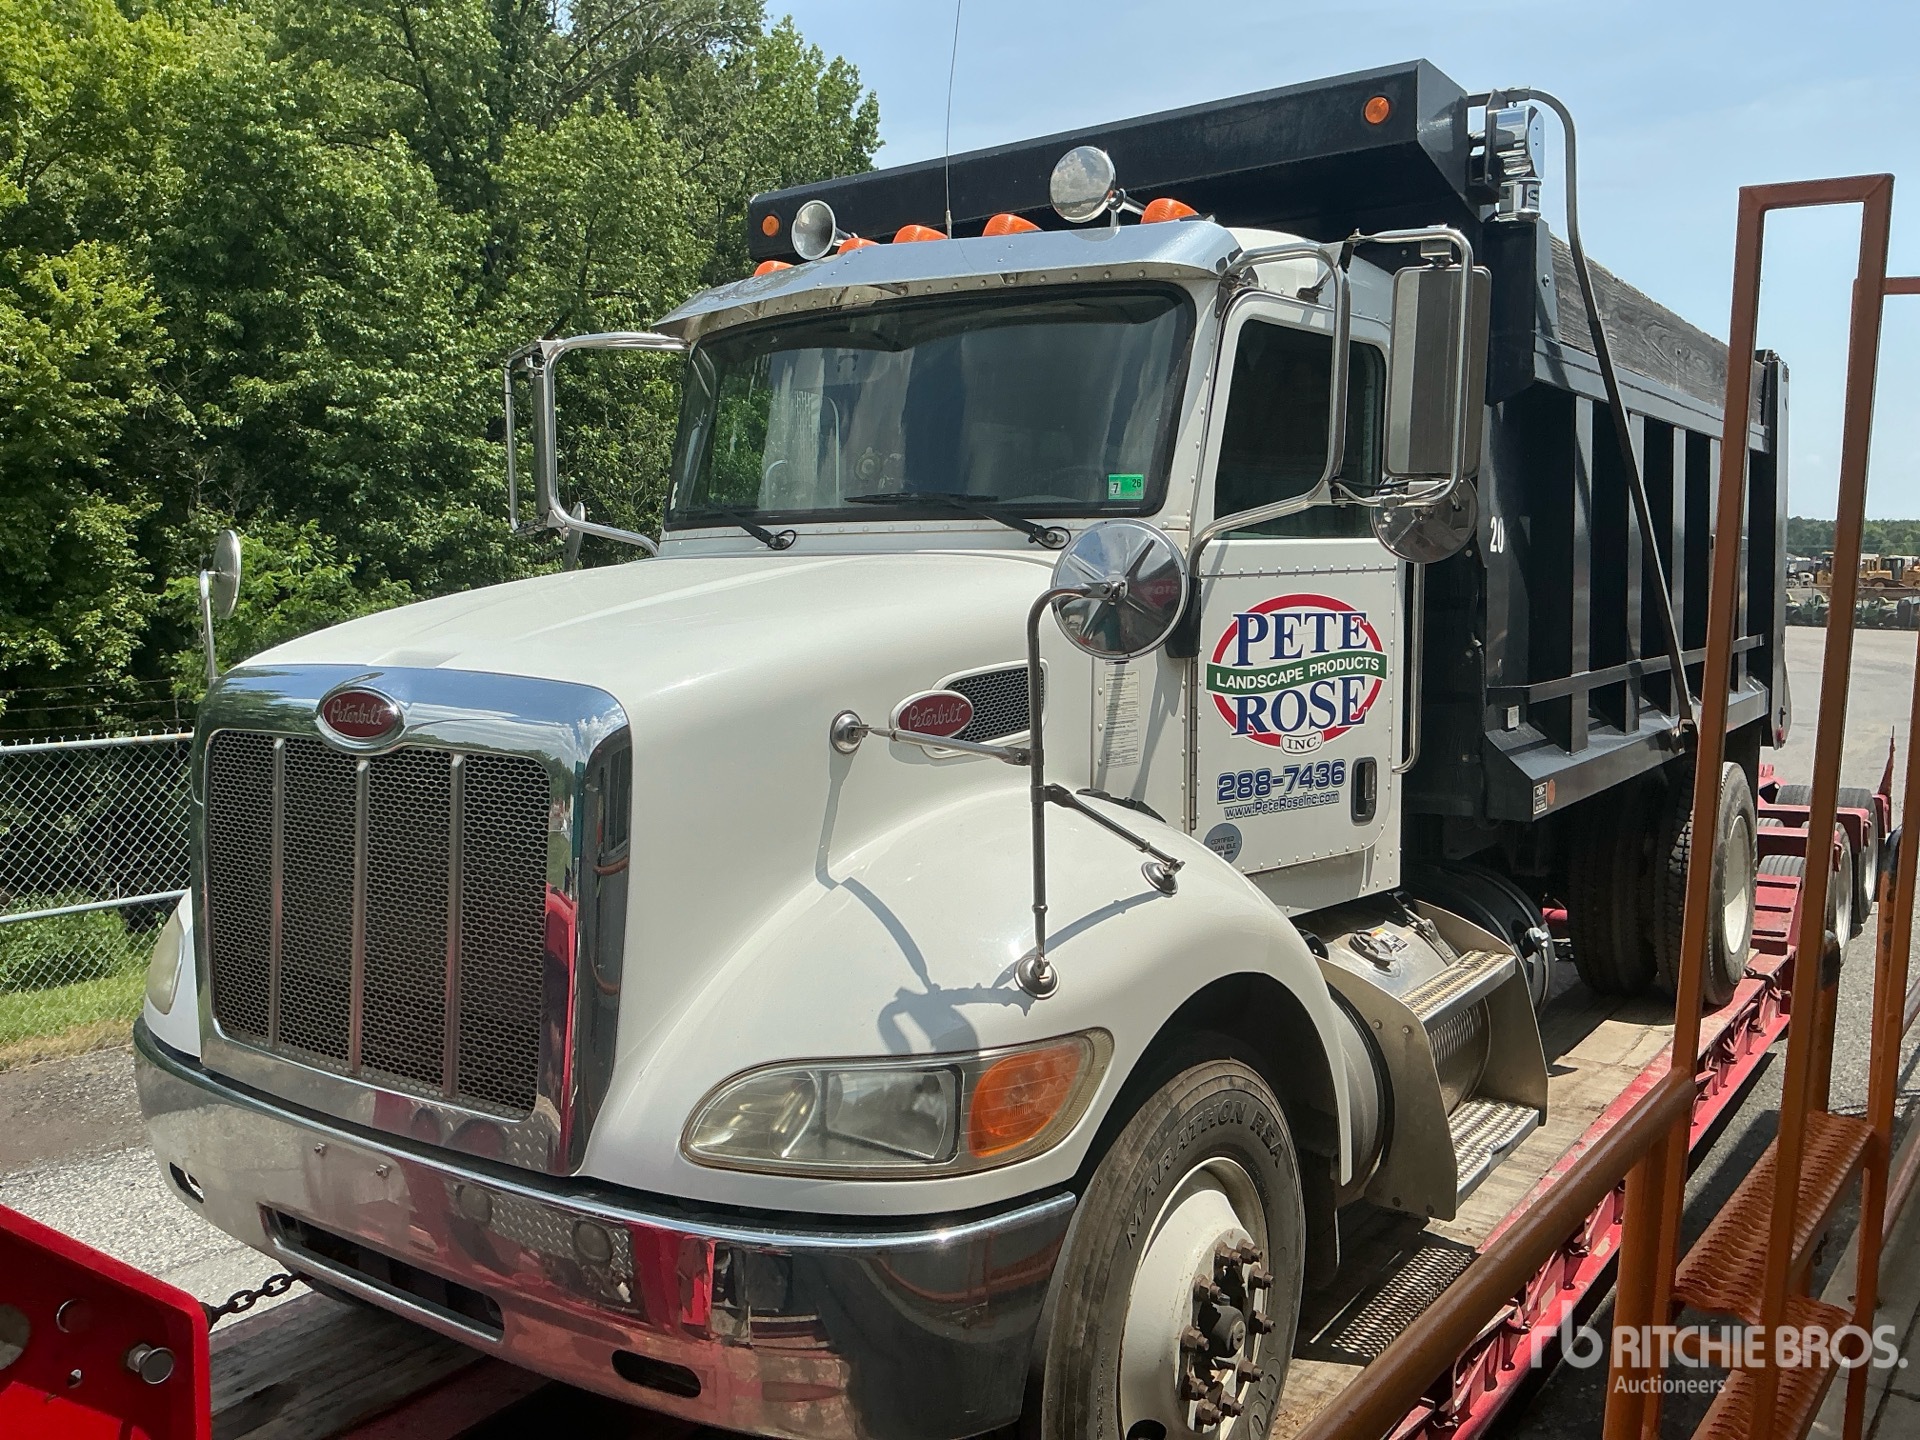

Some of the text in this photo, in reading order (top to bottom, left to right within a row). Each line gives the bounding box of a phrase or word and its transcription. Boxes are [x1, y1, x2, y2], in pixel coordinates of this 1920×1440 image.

[1113, 478, 1142, 494] 7 26
[1490, 515, 1504, 554] 20
[1232, 612, 1368, 667] PETE
[1216, 656, 1380, 690] LANDSCAPE PRODUCTS
[329, 698, 383, 726] Peterbilt
[907, 702, 967, 731] Peterbilt
[1231, 675, 1368, 736] ROSE
[1286, 734, 1320, 750] INC.
[1217, 759, 1346, 803] 288-7436
[1224, 792, 1340, 819] www.PeteRoseInc.com
[1126, 1098, 1247, 1249] MARATHON
[1249, 1109, 1283, 1169] RSA
